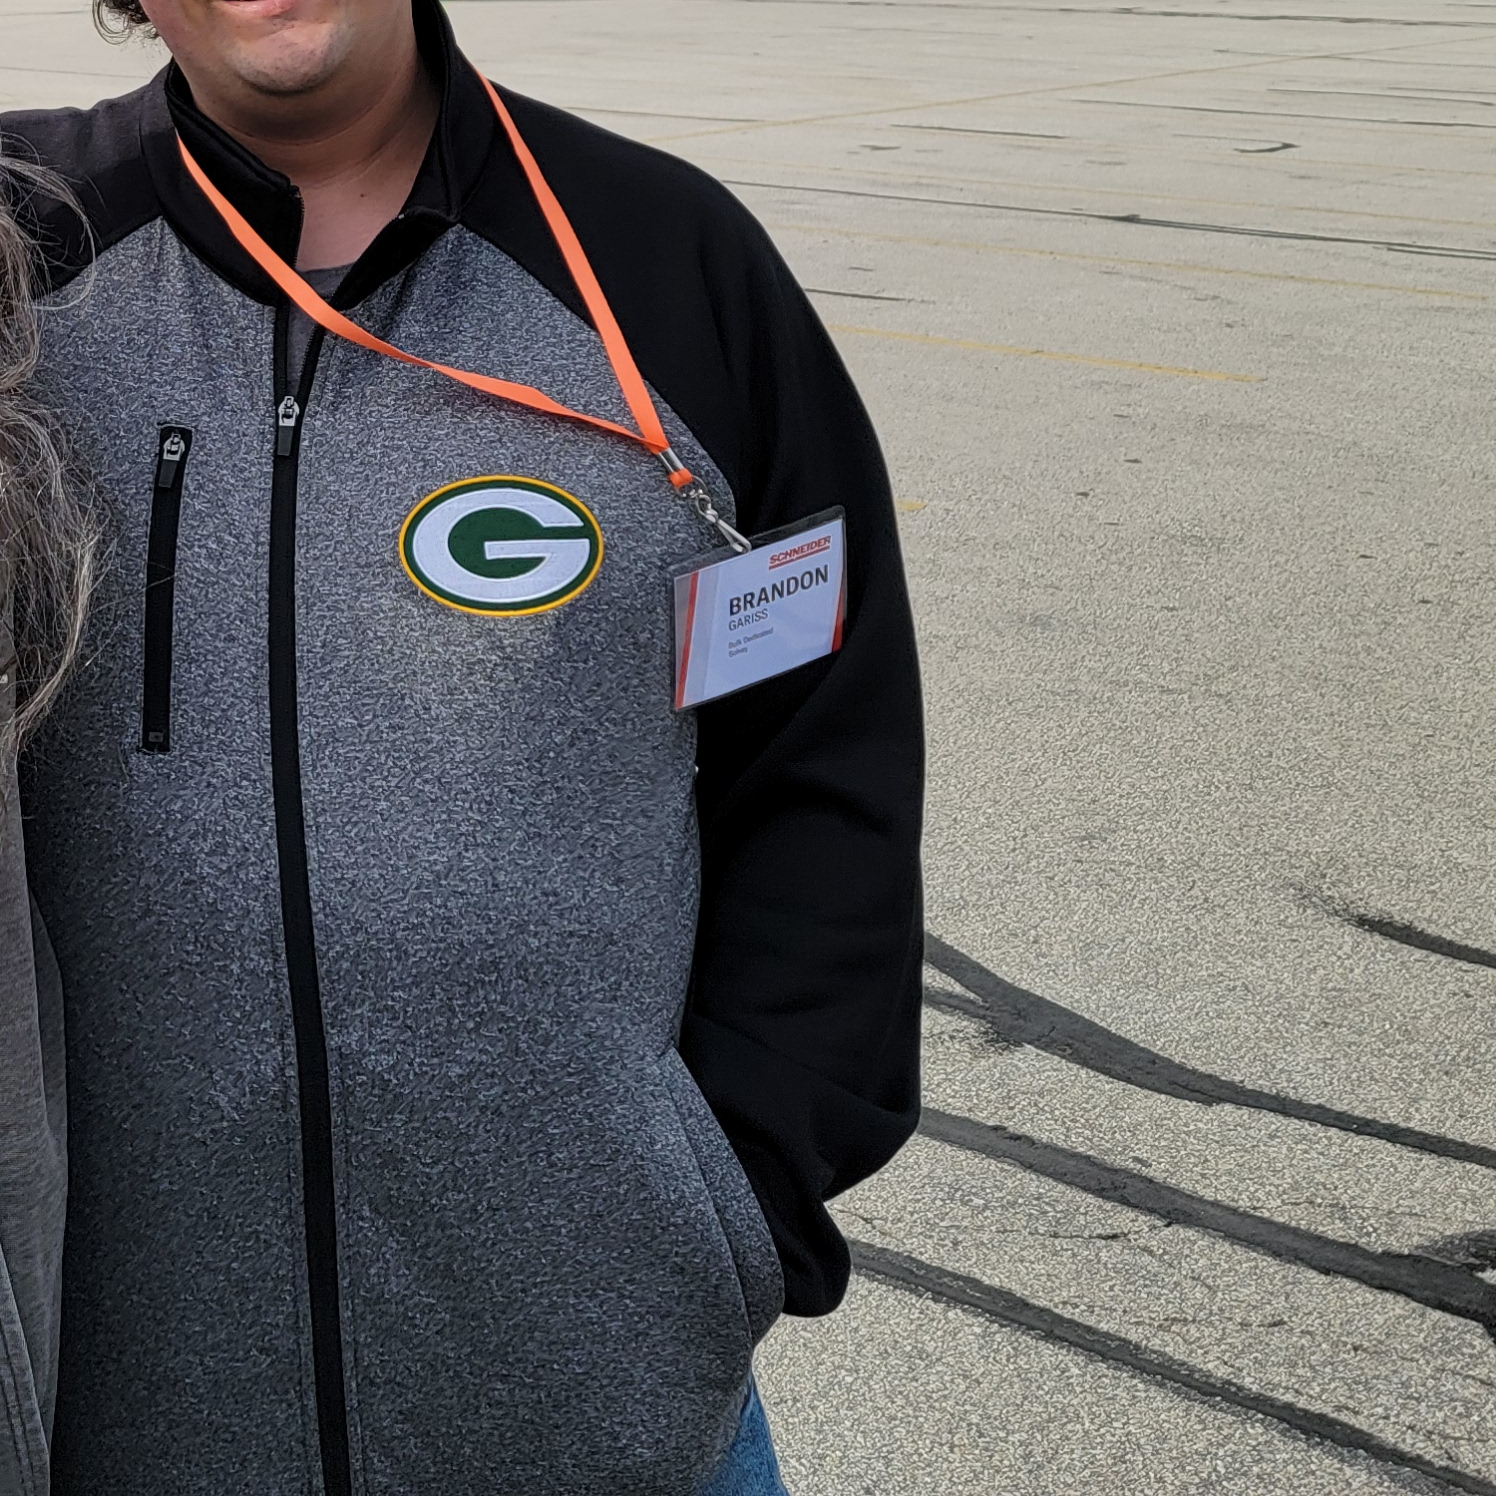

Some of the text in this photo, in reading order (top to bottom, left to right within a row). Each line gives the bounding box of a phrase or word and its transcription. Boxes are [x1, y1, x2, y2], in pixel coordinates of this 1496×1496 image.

[411, 485, 592, 605] G
[769, 536, 832, 565] SCHNEIDER
[729, 564, 829, 617] BRANDON
[728, 608, 769, 632] GARISS
